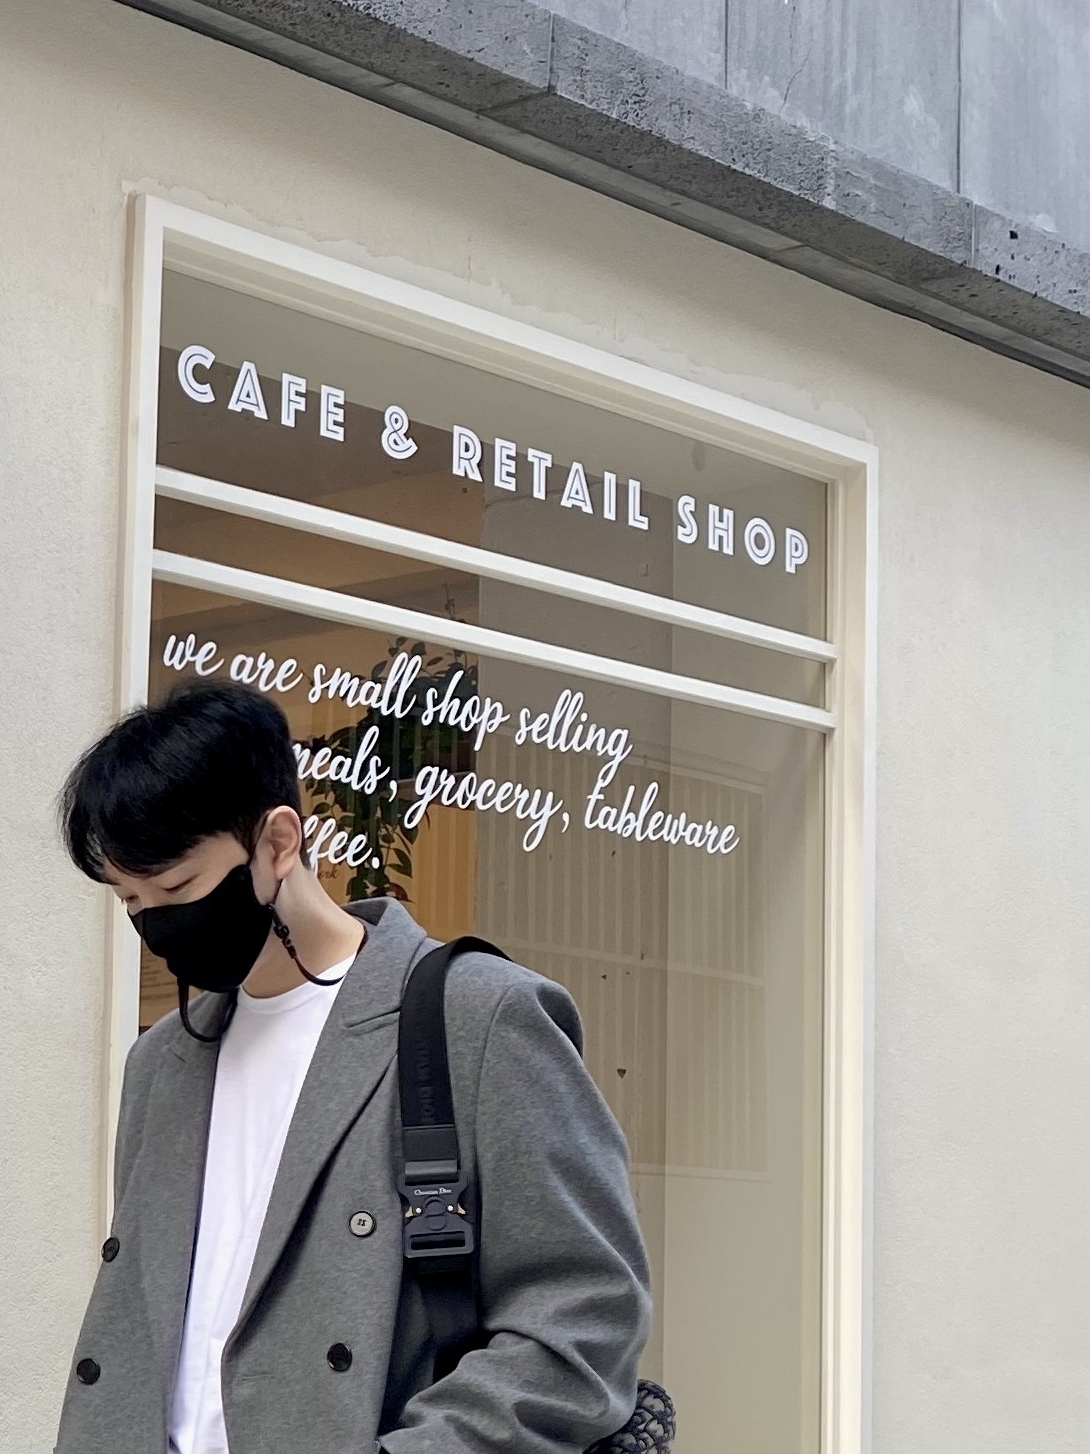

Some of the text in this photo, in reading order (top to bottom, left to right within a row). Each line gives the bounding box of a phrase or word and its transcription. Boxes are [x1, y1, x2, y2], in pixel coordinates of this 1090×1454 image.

[177, 344, 810, 574] CAFE & RETAIL SHOP
[163, 633, 634, 785] we are small shop selling
[404, 765, 570, 851] grocery,
[584, 777, 740, 854] tableware
